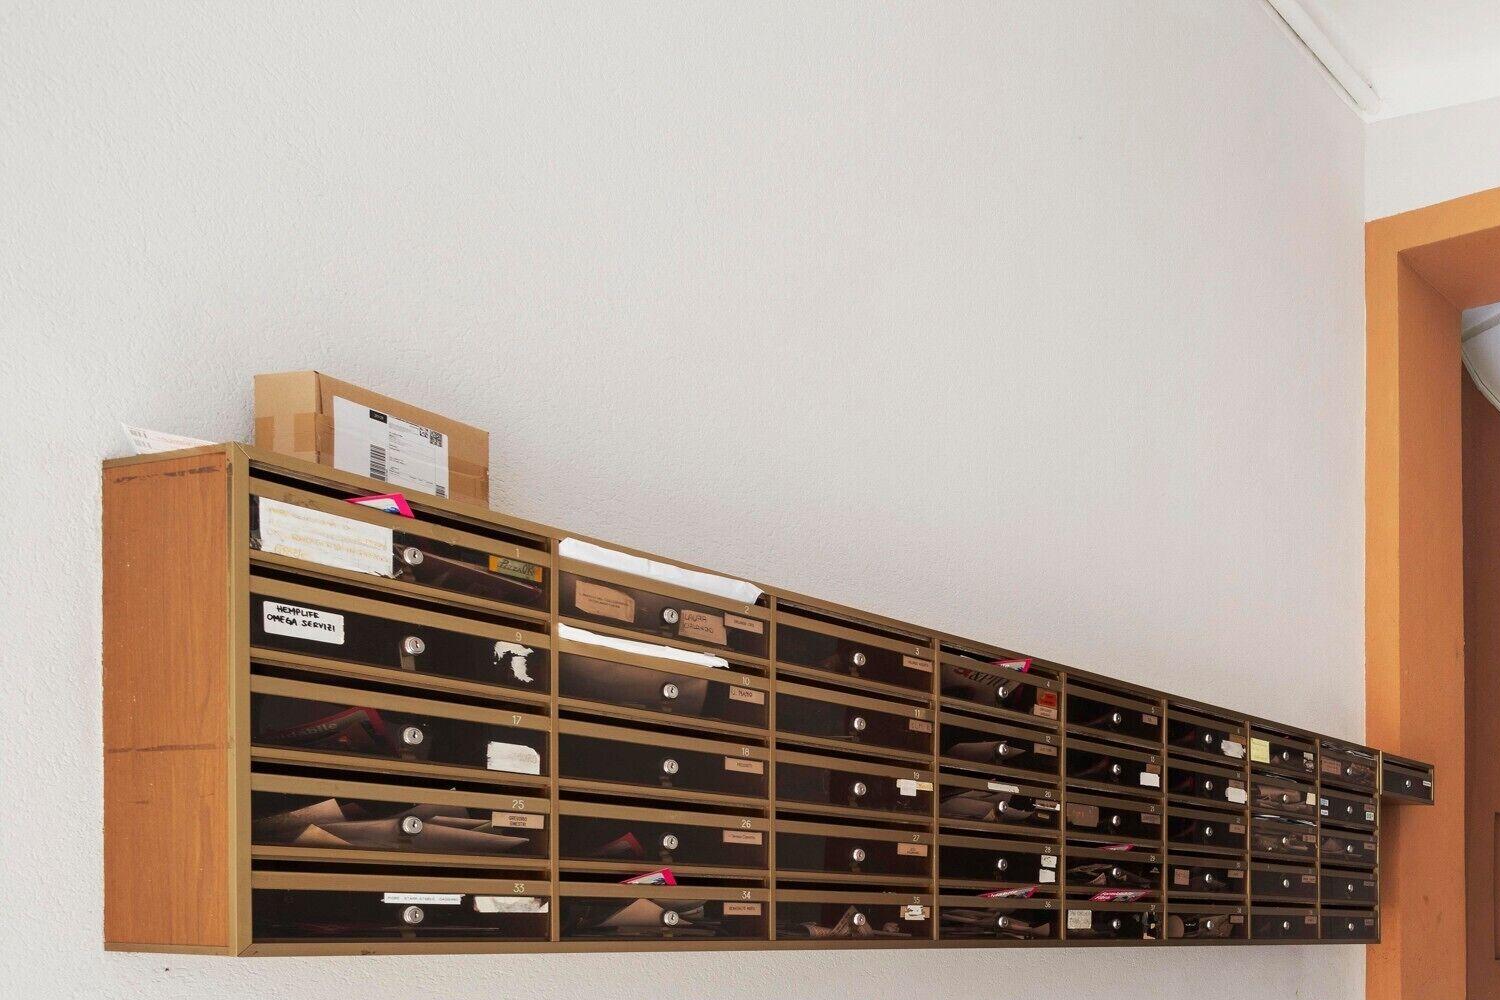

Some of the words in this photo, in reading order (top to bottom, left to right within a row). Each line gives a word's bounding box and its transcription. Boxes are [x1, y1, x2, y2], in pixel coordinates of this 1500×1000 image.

[515, 548, 520, 558] 1
[276, 605, 320, 619] HEMPLIFE
[744, 605, 750, 614] 2
[266, 613, 298, 627] OMEGA
[301, 620, 336, 632] SERVIZI
[515, 631, 522, 642] 9
[914, 647, 919, 656] 3
[742, 677, 750, 686] 10
[914, 709, 921, 718] 11
[512, 715, 522, 726] 17
[742, 747, 750, 756] 18
[913, 771, 920, 780] 19
[1044, 790, 1052, 799] 20
[512, 799, 525, 810] 25
[741, 819, 751, 829] 26
[912, 834, 920, 843] 27
[513, 883, 525, 894] 33
[741, 891, 751, 900] 34
[913, 896, 921, 905] 35
